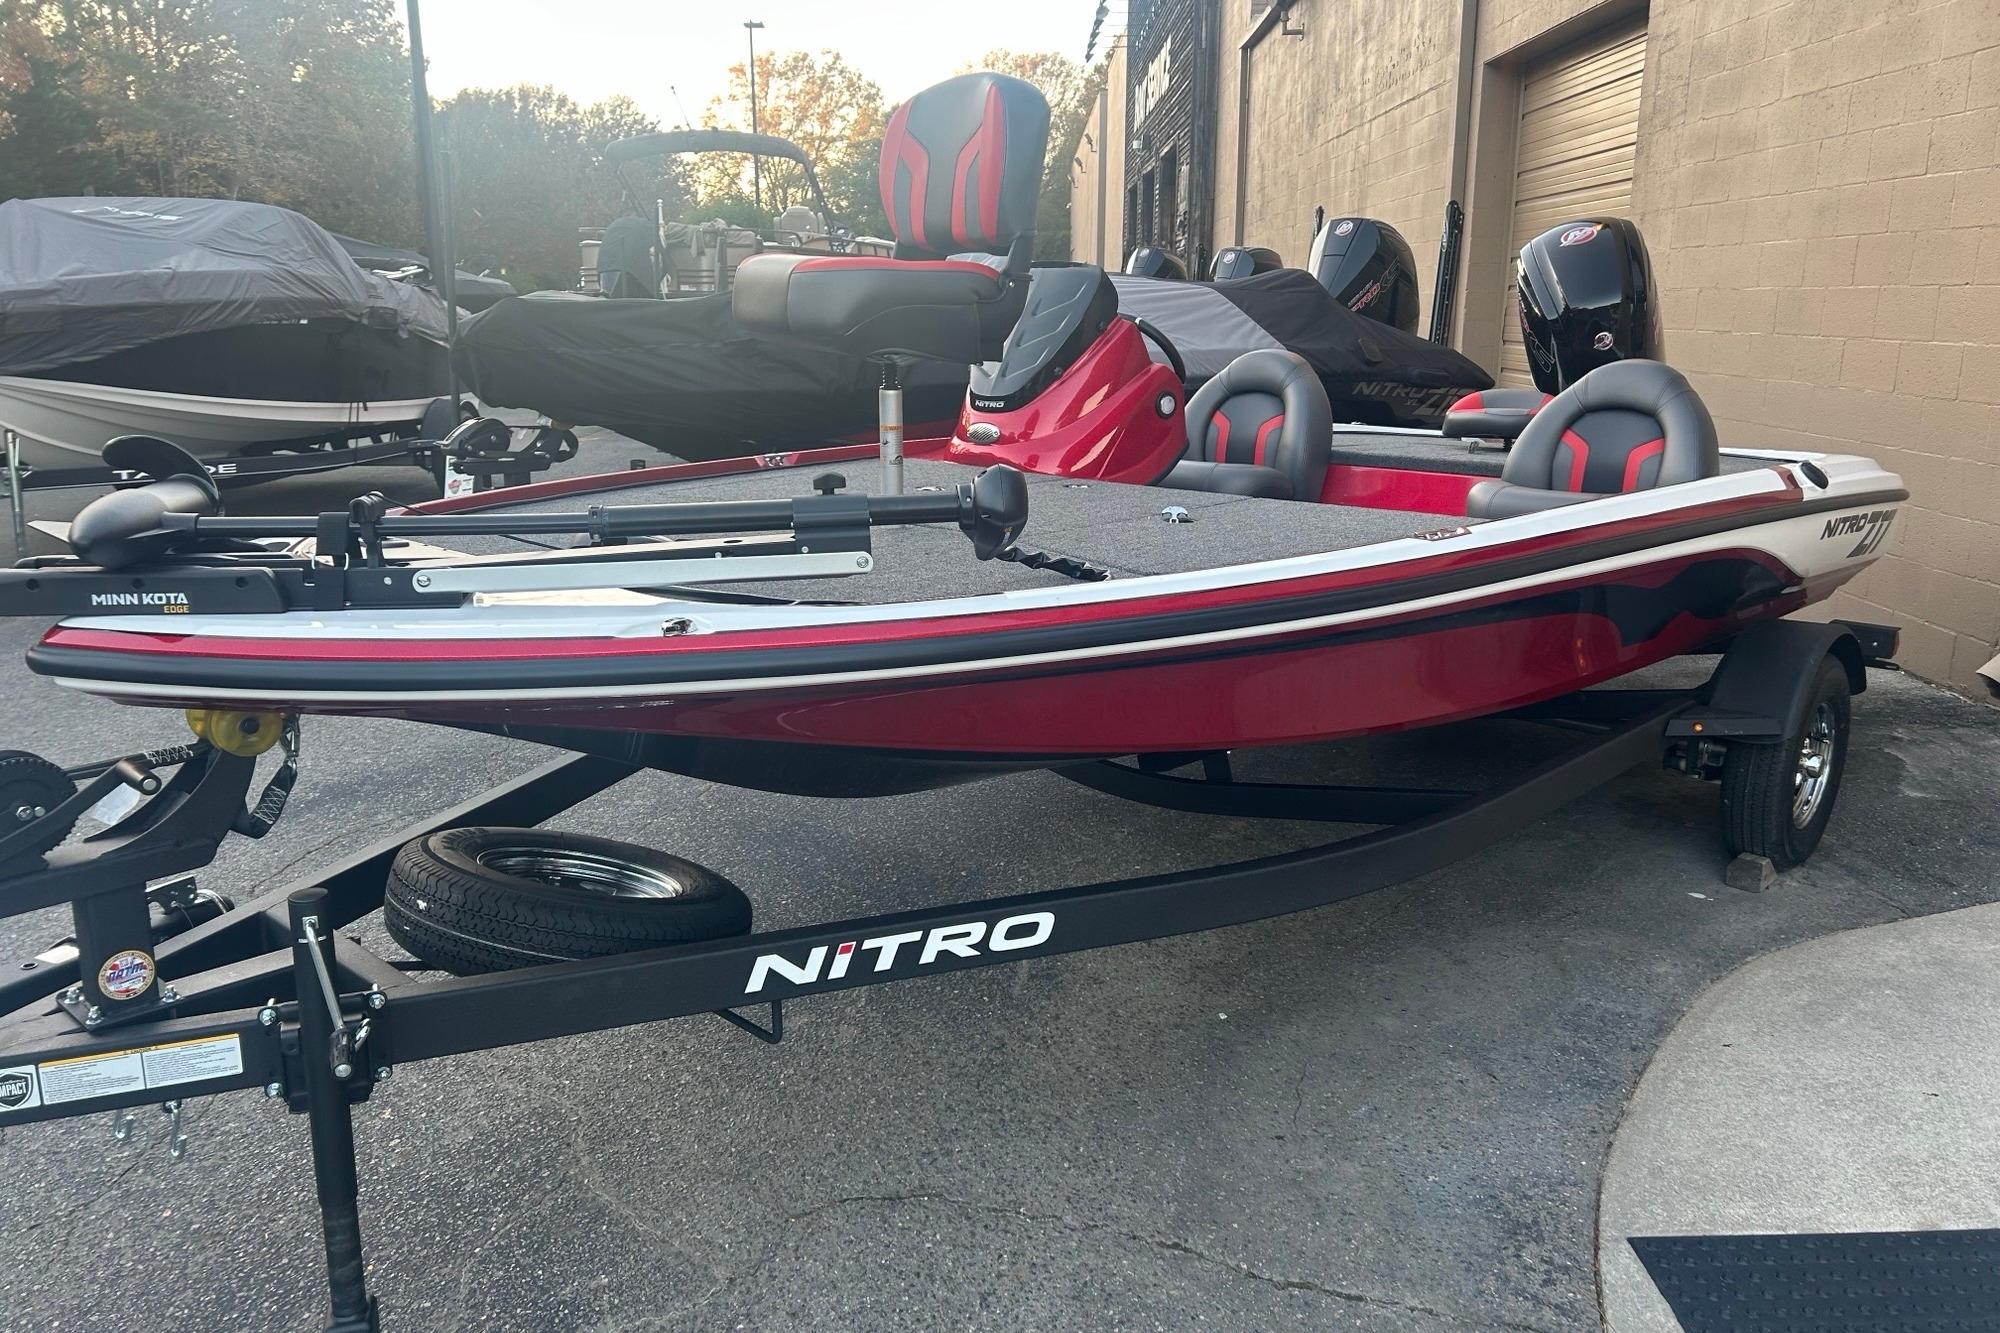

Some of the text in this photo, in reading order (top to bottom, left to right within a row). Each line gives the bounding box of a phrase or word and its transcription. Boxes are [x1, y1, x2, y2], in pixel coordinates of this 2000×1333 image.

[975, 400, 1005, 408] NITRO
[1820, 512, 1869, 540] NITRO
[91, 592, 189, 606] MINN KOTA
[163, 605, 189, 613] EDGE
[744, 911, 1055, 994] NITRO
